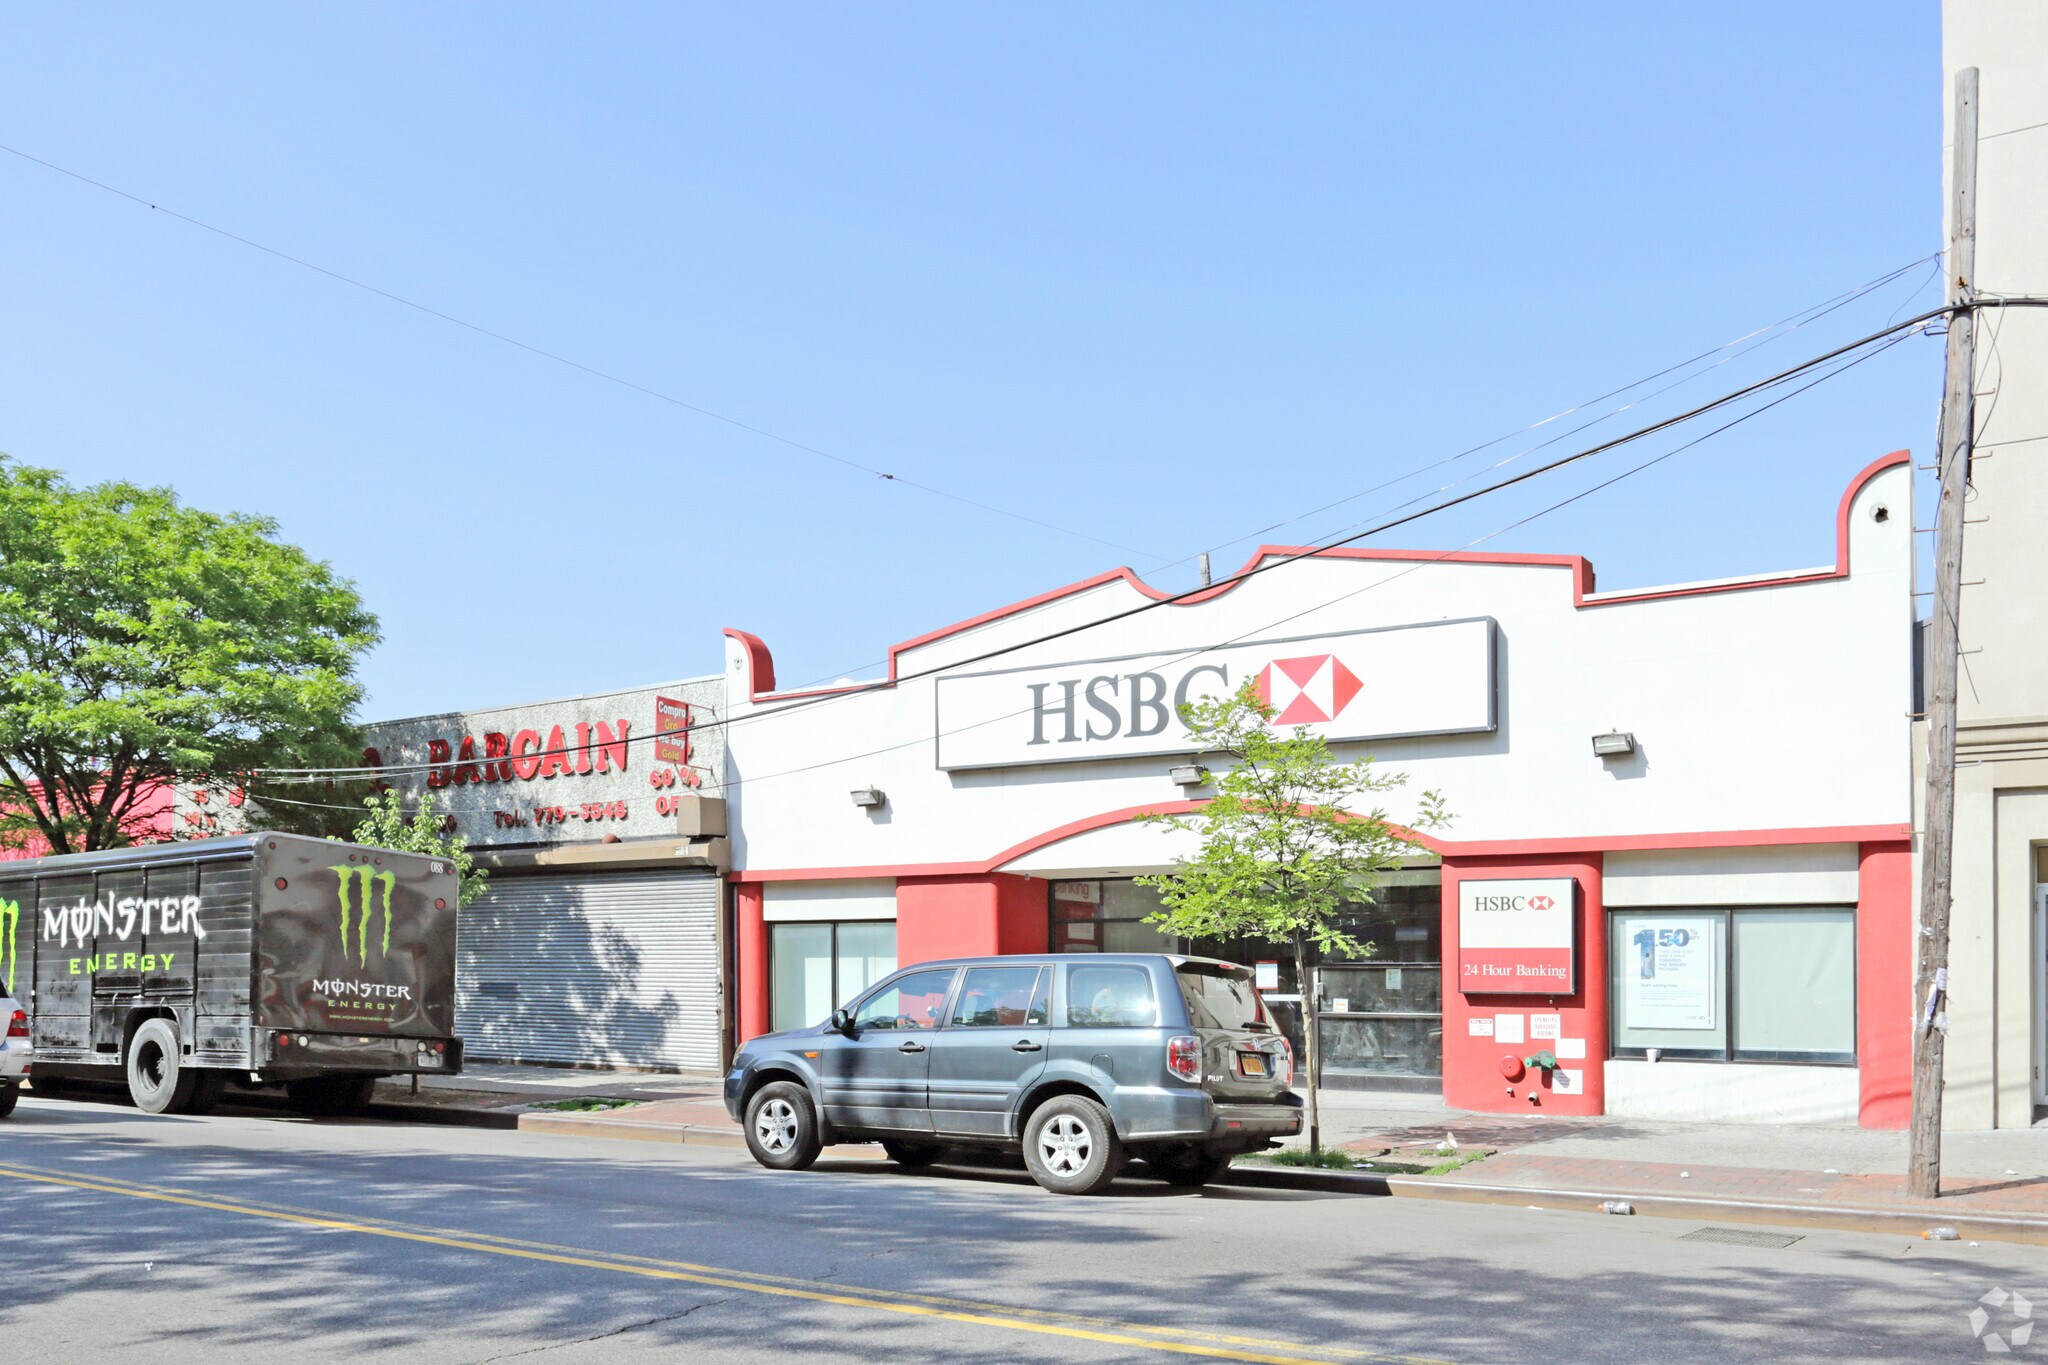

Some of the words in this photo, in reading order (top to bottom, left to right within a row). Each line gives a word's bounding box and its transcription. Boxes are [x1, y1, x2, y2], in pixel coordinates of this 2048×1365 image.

[658, 700, 687, 719] Compro
[1026, 663, 1229, 745] HSBC
[664, 718, 678, 731] Oro
[671, 736, 686, 750] buy
[426, 718, 630, 788] BARGAIN
[662, 748, 680, 761] Gold
[655, 795, 690, 815] OF
[431, 861, 444, 874] 088
[1474, 895, 1526, 911] HSBC
[43, 890, 207, 949] MONSTER
[69, 952, 175, 975] ENERGY
[1463, 964, 1478, 976] 24
[1482, 963, 1512, 977] Hour
[1516, 963, 1567, 980] Banking
[312, 978, 412, 1000] MONSTER
[327, 999, 397, 1011] ENERGY
